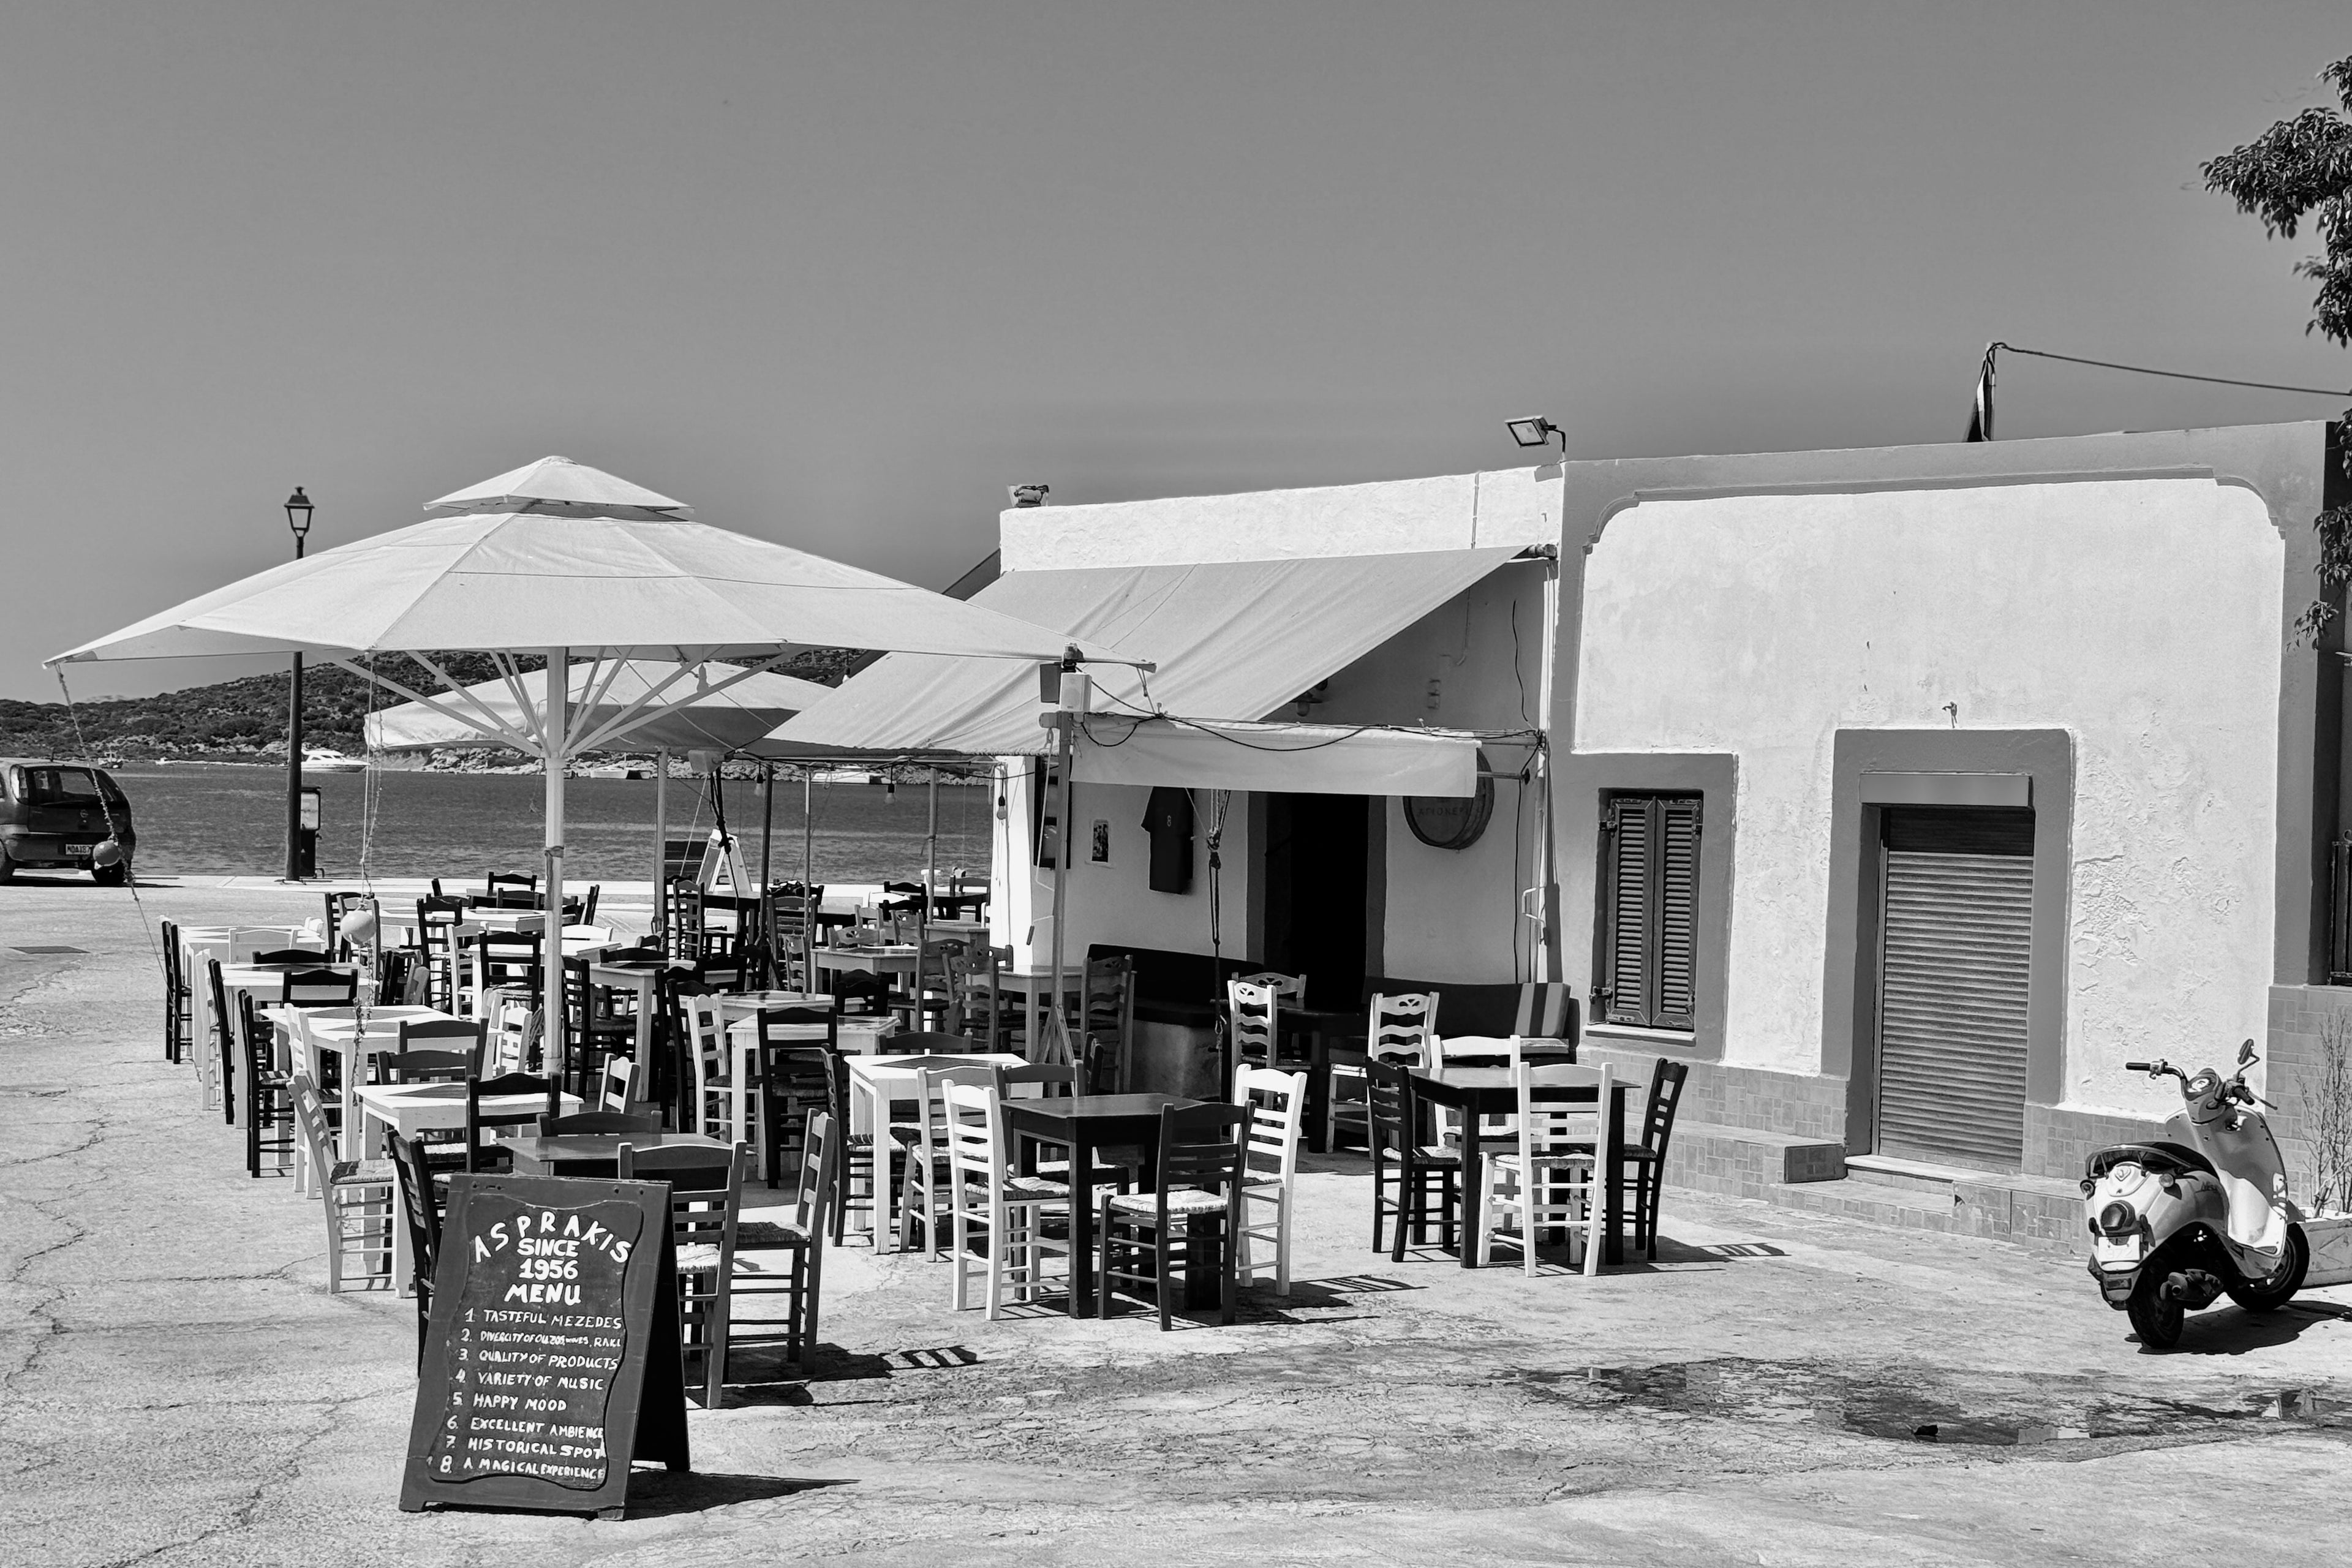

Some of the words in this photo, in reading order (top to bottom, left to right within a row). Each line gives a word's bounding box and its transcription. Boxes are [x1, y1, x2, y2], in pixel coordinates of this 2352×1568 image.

[474, 1211, 631, 1263] ASPRAKIS
[516, 1238, 581, 1257] SINCE
[518, 1258, 579, 1280] 1956
[503, 1283, 581, 1306] MENU
[483, 1309, 547, 1324] TASTEFUL
[551, 1315, 622, 1329] MEZEDES
[523, 1333, 535, 1343] OF
[594, 1337, 621, 1348] RAKI
[479, 1350, 529, 1363] QUALITY
[529, 1353, 546, 1364] OF
[548, 1355, 619, 1370] PRODUCTS
[478, 1372, 532, 1386] VARIETY
[534, 1375, 552, 1387] OF
[557, 1377, 604, 1390] MUSIC
[473, 1392, 519, 1410] HAPPY
[524, 1398, 567, 1411] MOOD
[470, 1417, 545, 1433] EXCELLENT
[549, 1424, 604, 1439] AMBIENCE
[467, 1437, 557, 1455] HISTORICAL
[463, 1457, 473, 1469] A
[478, 1458, 539, 1475] MAGICAL
[540, 1463, 606, 1479] EXPERIENCE
